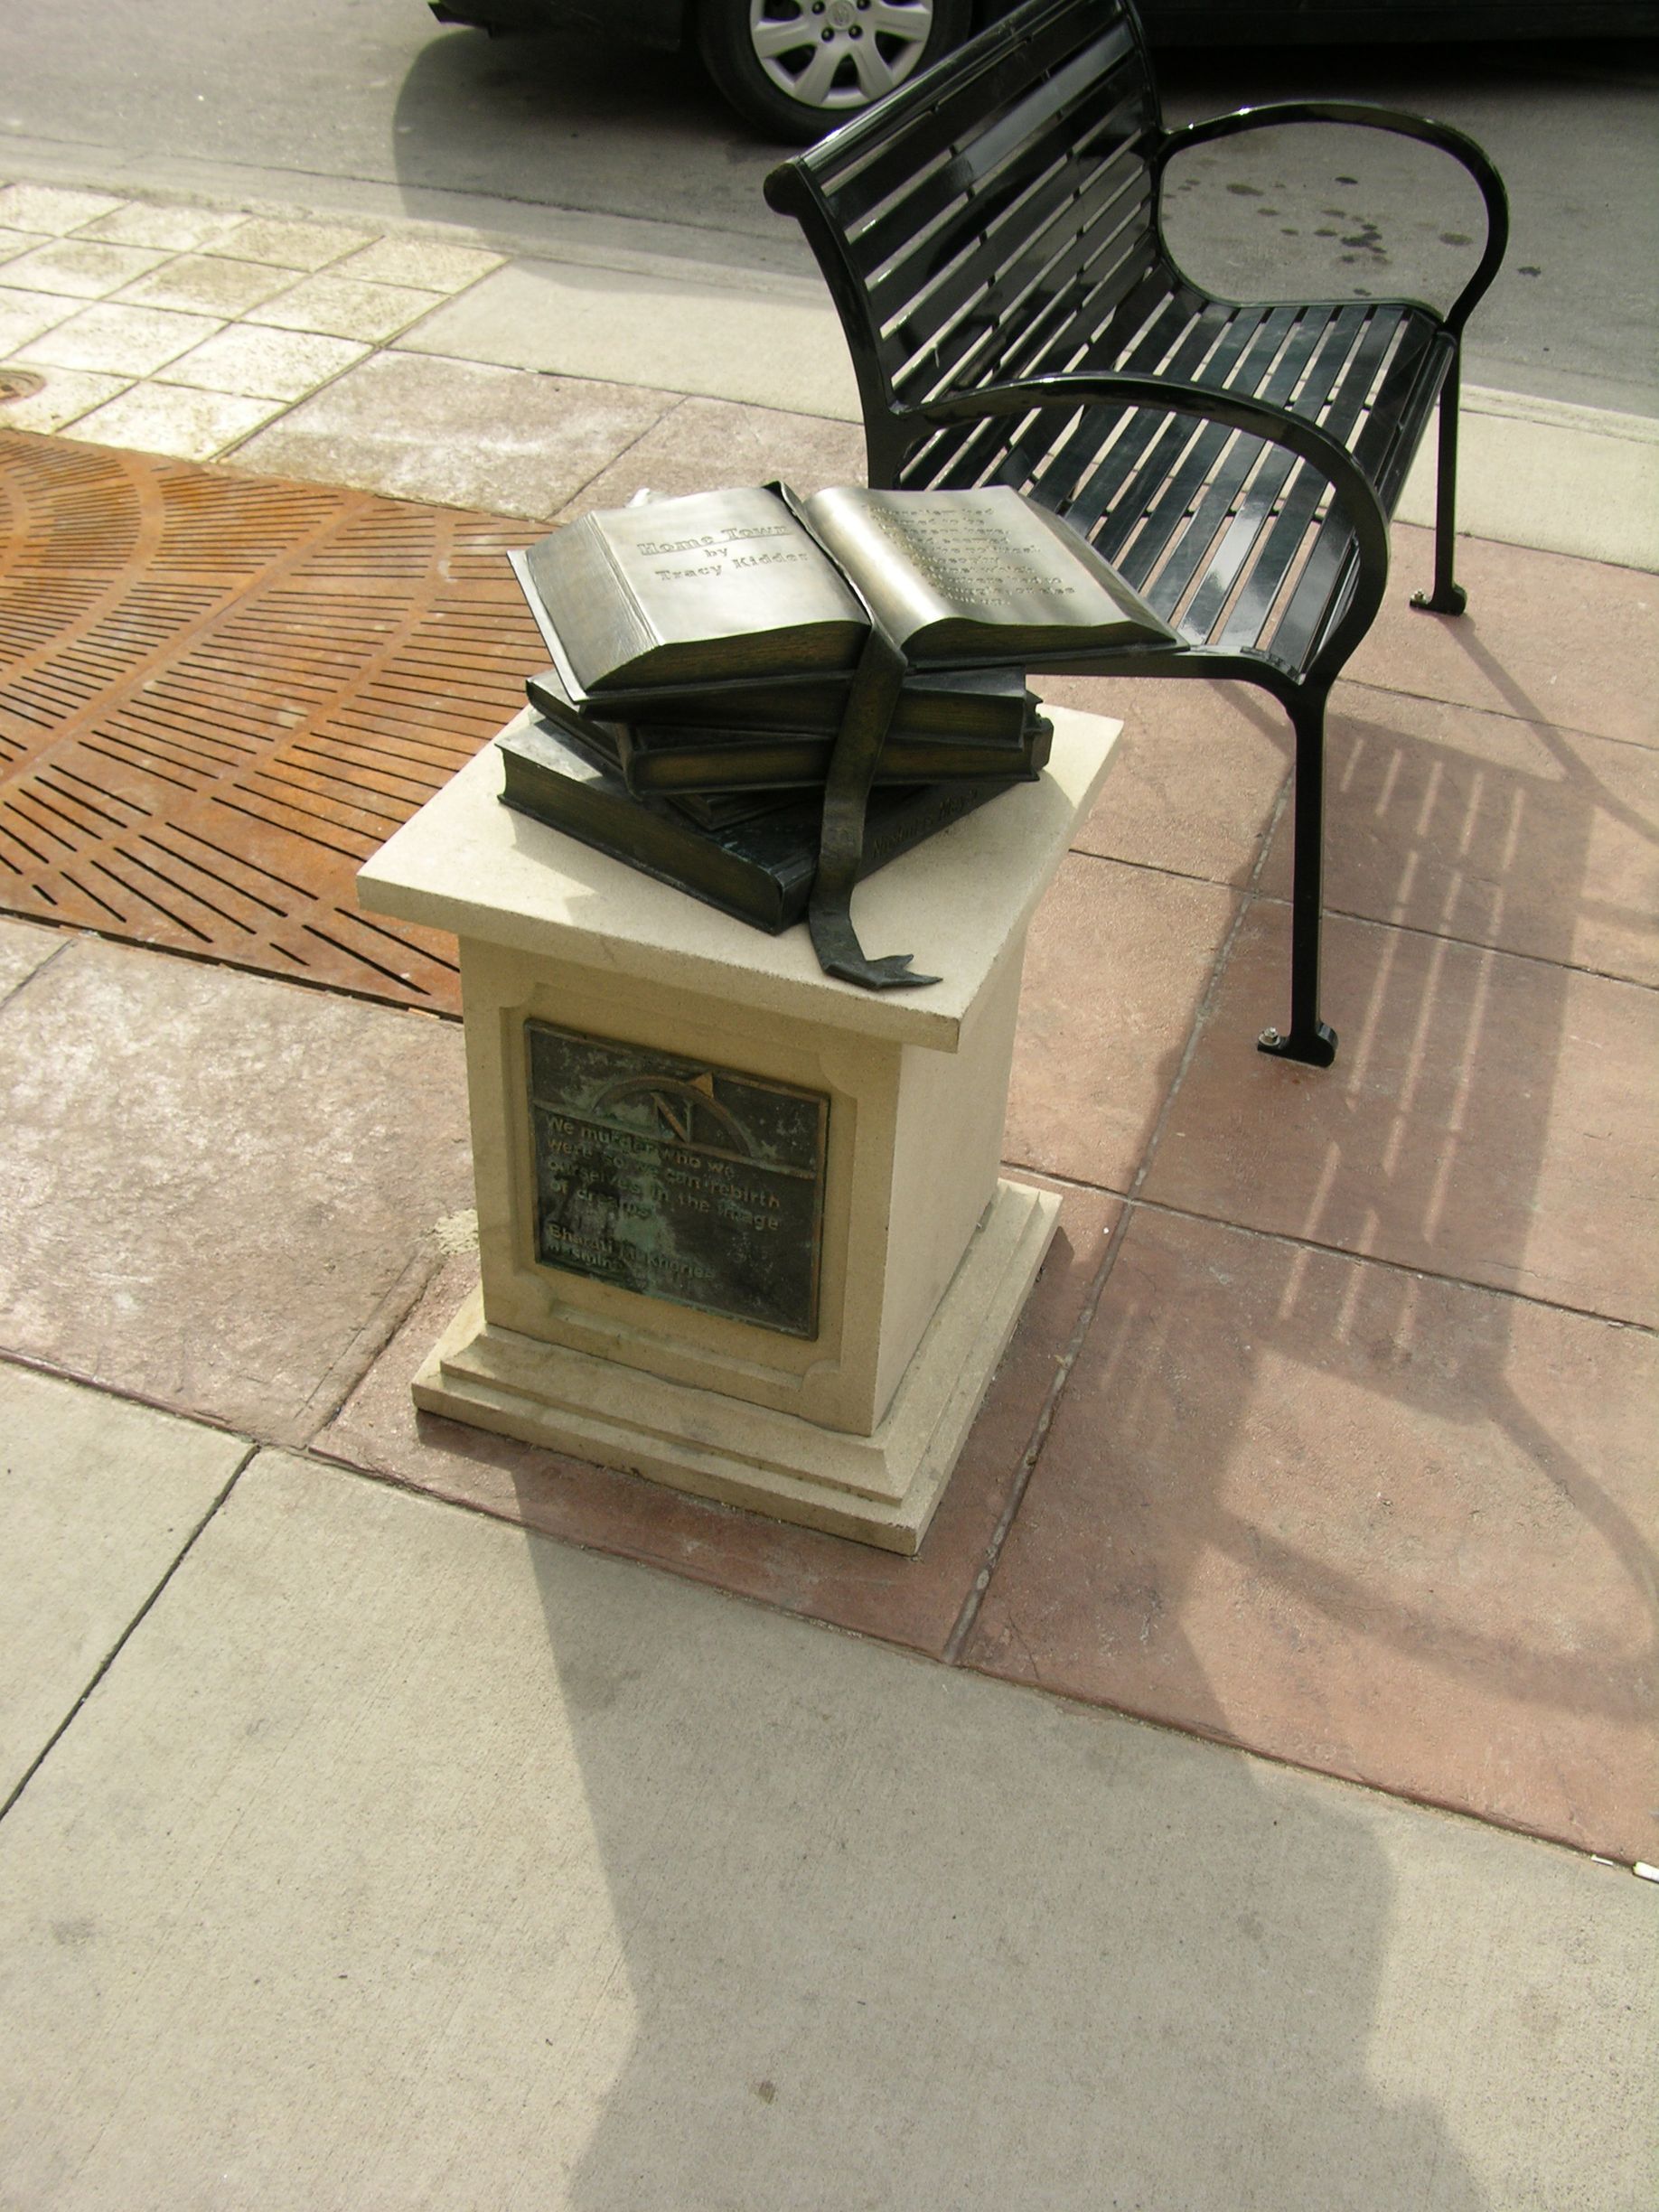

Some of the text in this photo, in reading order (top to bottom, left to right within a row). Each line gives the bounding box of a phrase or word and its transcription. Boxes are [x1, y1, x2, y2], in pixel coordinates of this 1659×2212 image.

[636, 524, 790, 558] Home Town
[702, 547, 728, 558] by
[654, 551, 810, 581] Tracy Kidder
[546, 1115, 575, 1136] We
[580, 1126, 655, 1154] murder
[708, 1160, 735, 1181] we
[547, 1139, 594, 1159] were
[709, 1182, 782, 1210] rebirth
[548, 1177, 570, 1196] of
[547, 1158, 642, 1196] ourselves
[677, 1191, 711, 1214] the
[718, 1202, 782, 1232] image
